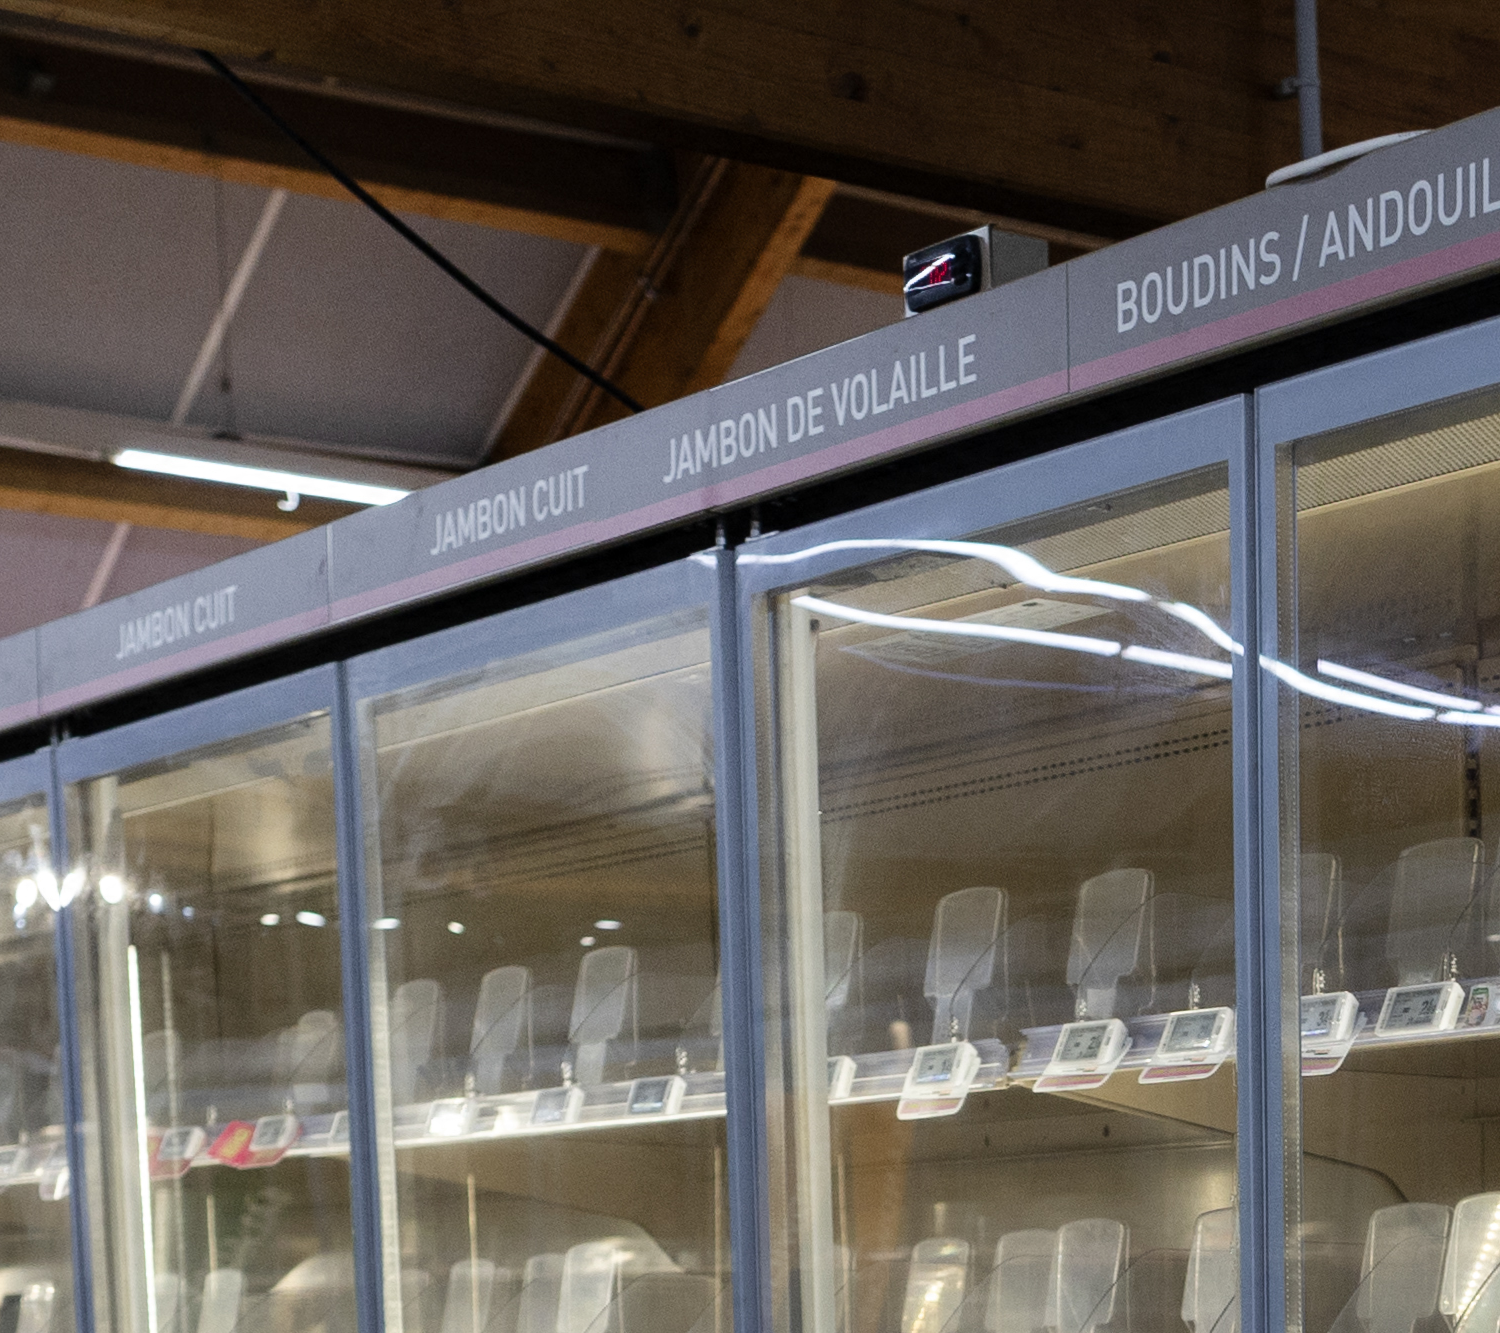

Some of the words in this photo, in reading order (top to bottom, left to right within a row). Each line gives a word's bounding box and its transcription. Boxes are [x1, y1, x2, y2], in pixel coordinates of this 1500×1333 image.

[1114, 215, 1283, 335] BOUDINS
[663, 403, 778, 485] JAMBON
[786, 386, 825, 445] DE
[831, 333, 979, 429] VOLAILLE
[429, 493, 527, 556] JAMBON
[533, 464, 590, 523] CUIT
[114, 606, 190, 660] JAMBON
[193, 584, 238, 633] CUIT
